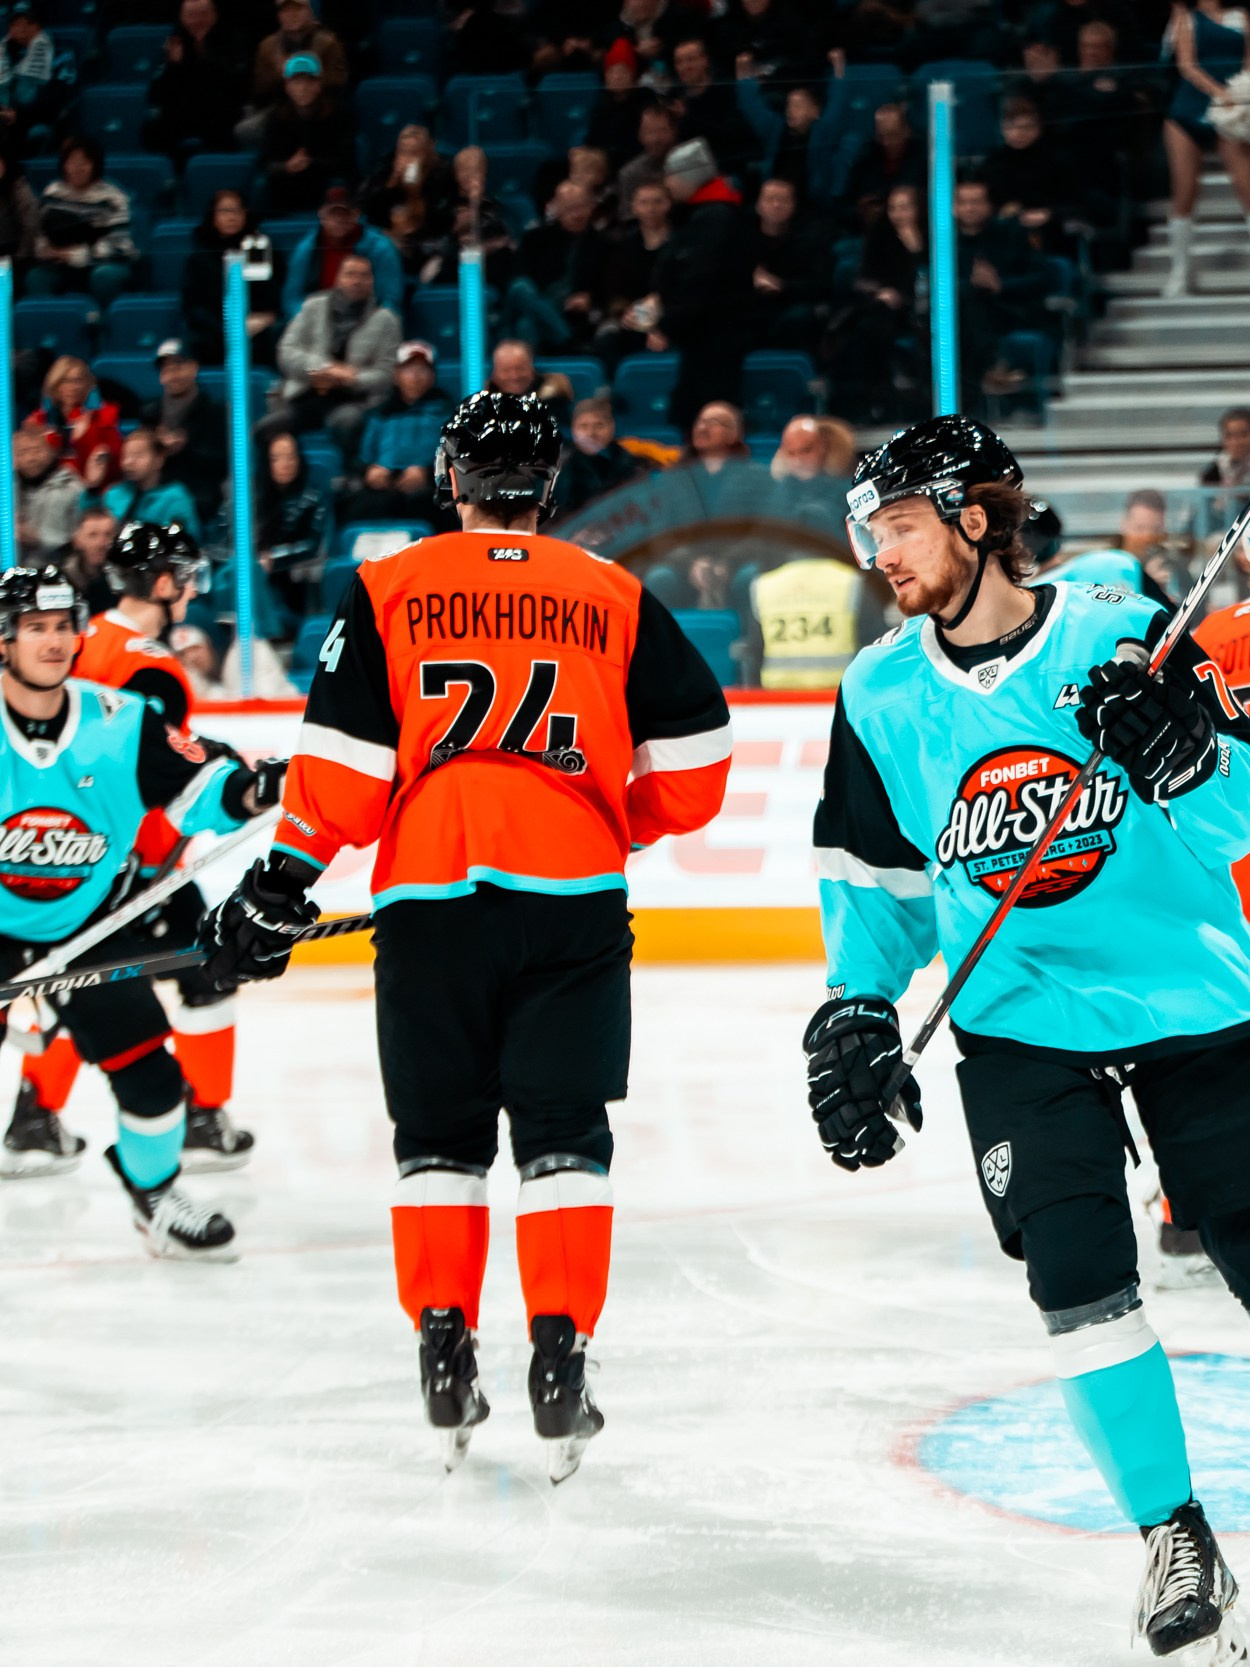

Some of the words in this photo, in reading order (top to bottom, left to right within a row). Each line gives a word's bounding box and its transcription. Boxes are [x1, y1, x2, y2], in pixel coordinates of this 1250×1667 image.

[406, 592, 608, 655] PROKHORKIN
[770, 616, 833, 641] 234
[419, 660, 588, 776] 24
[980, 757, 1050, 787] FONBET
[937, 774, 1125, 863] All-Star
[0, 826, 108, 866] ll-Star
[973, 861, 989, 873] ST.
[1075, 834, 1103, 850] 2023
[18, 972, 101, 999] ALPHA
[109, 963, 145, 983] LX
